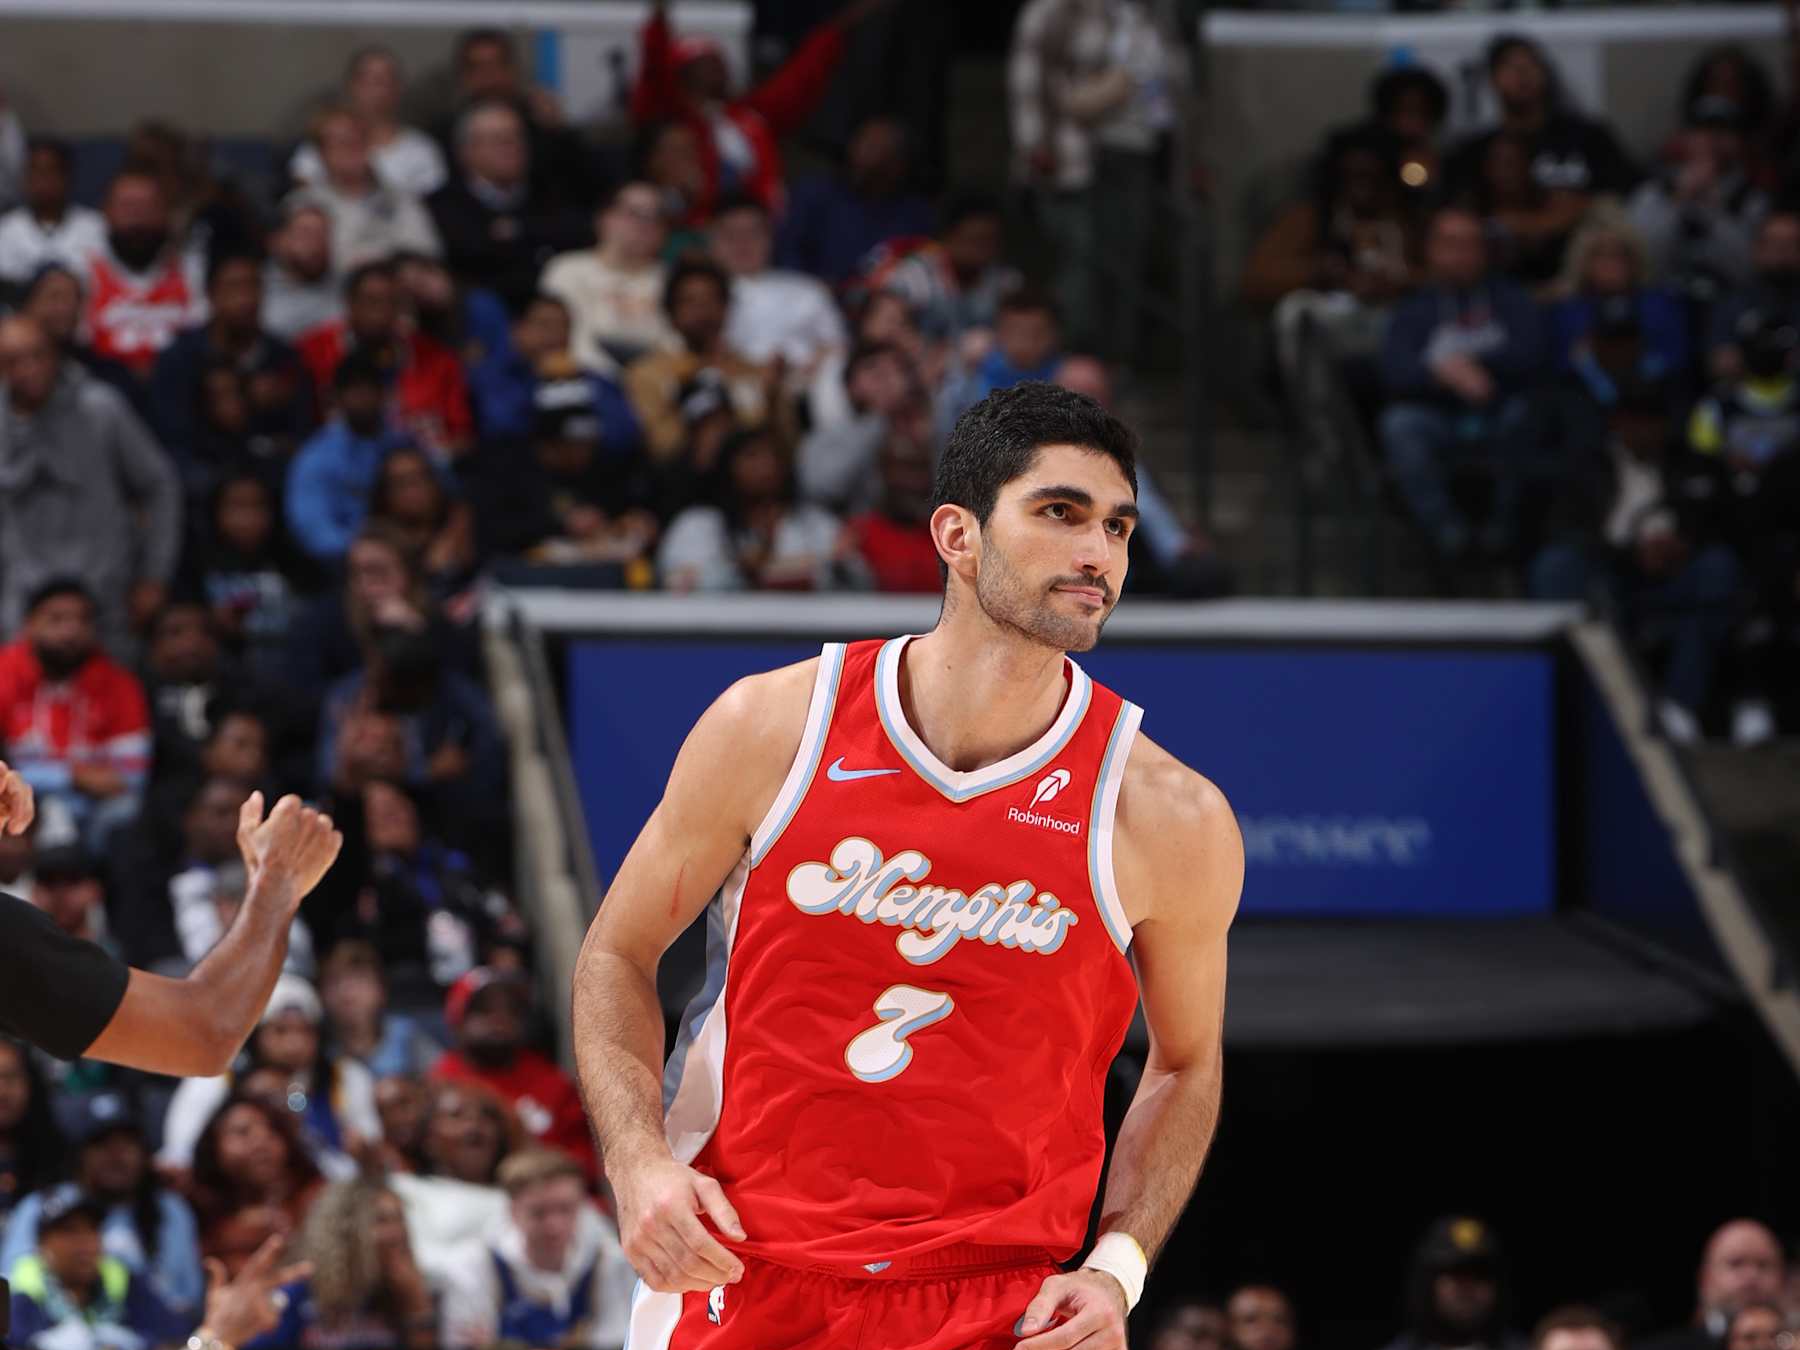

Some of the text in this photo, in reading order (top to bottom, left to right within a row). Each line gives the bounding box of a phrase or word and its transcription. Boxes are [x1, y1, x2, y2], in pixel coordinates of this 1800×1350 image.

[1008, 807, 1080, 834] Robinhood
[787, 837, 1079, 966] Memphis
[845, 985, 955, 1083] 7
